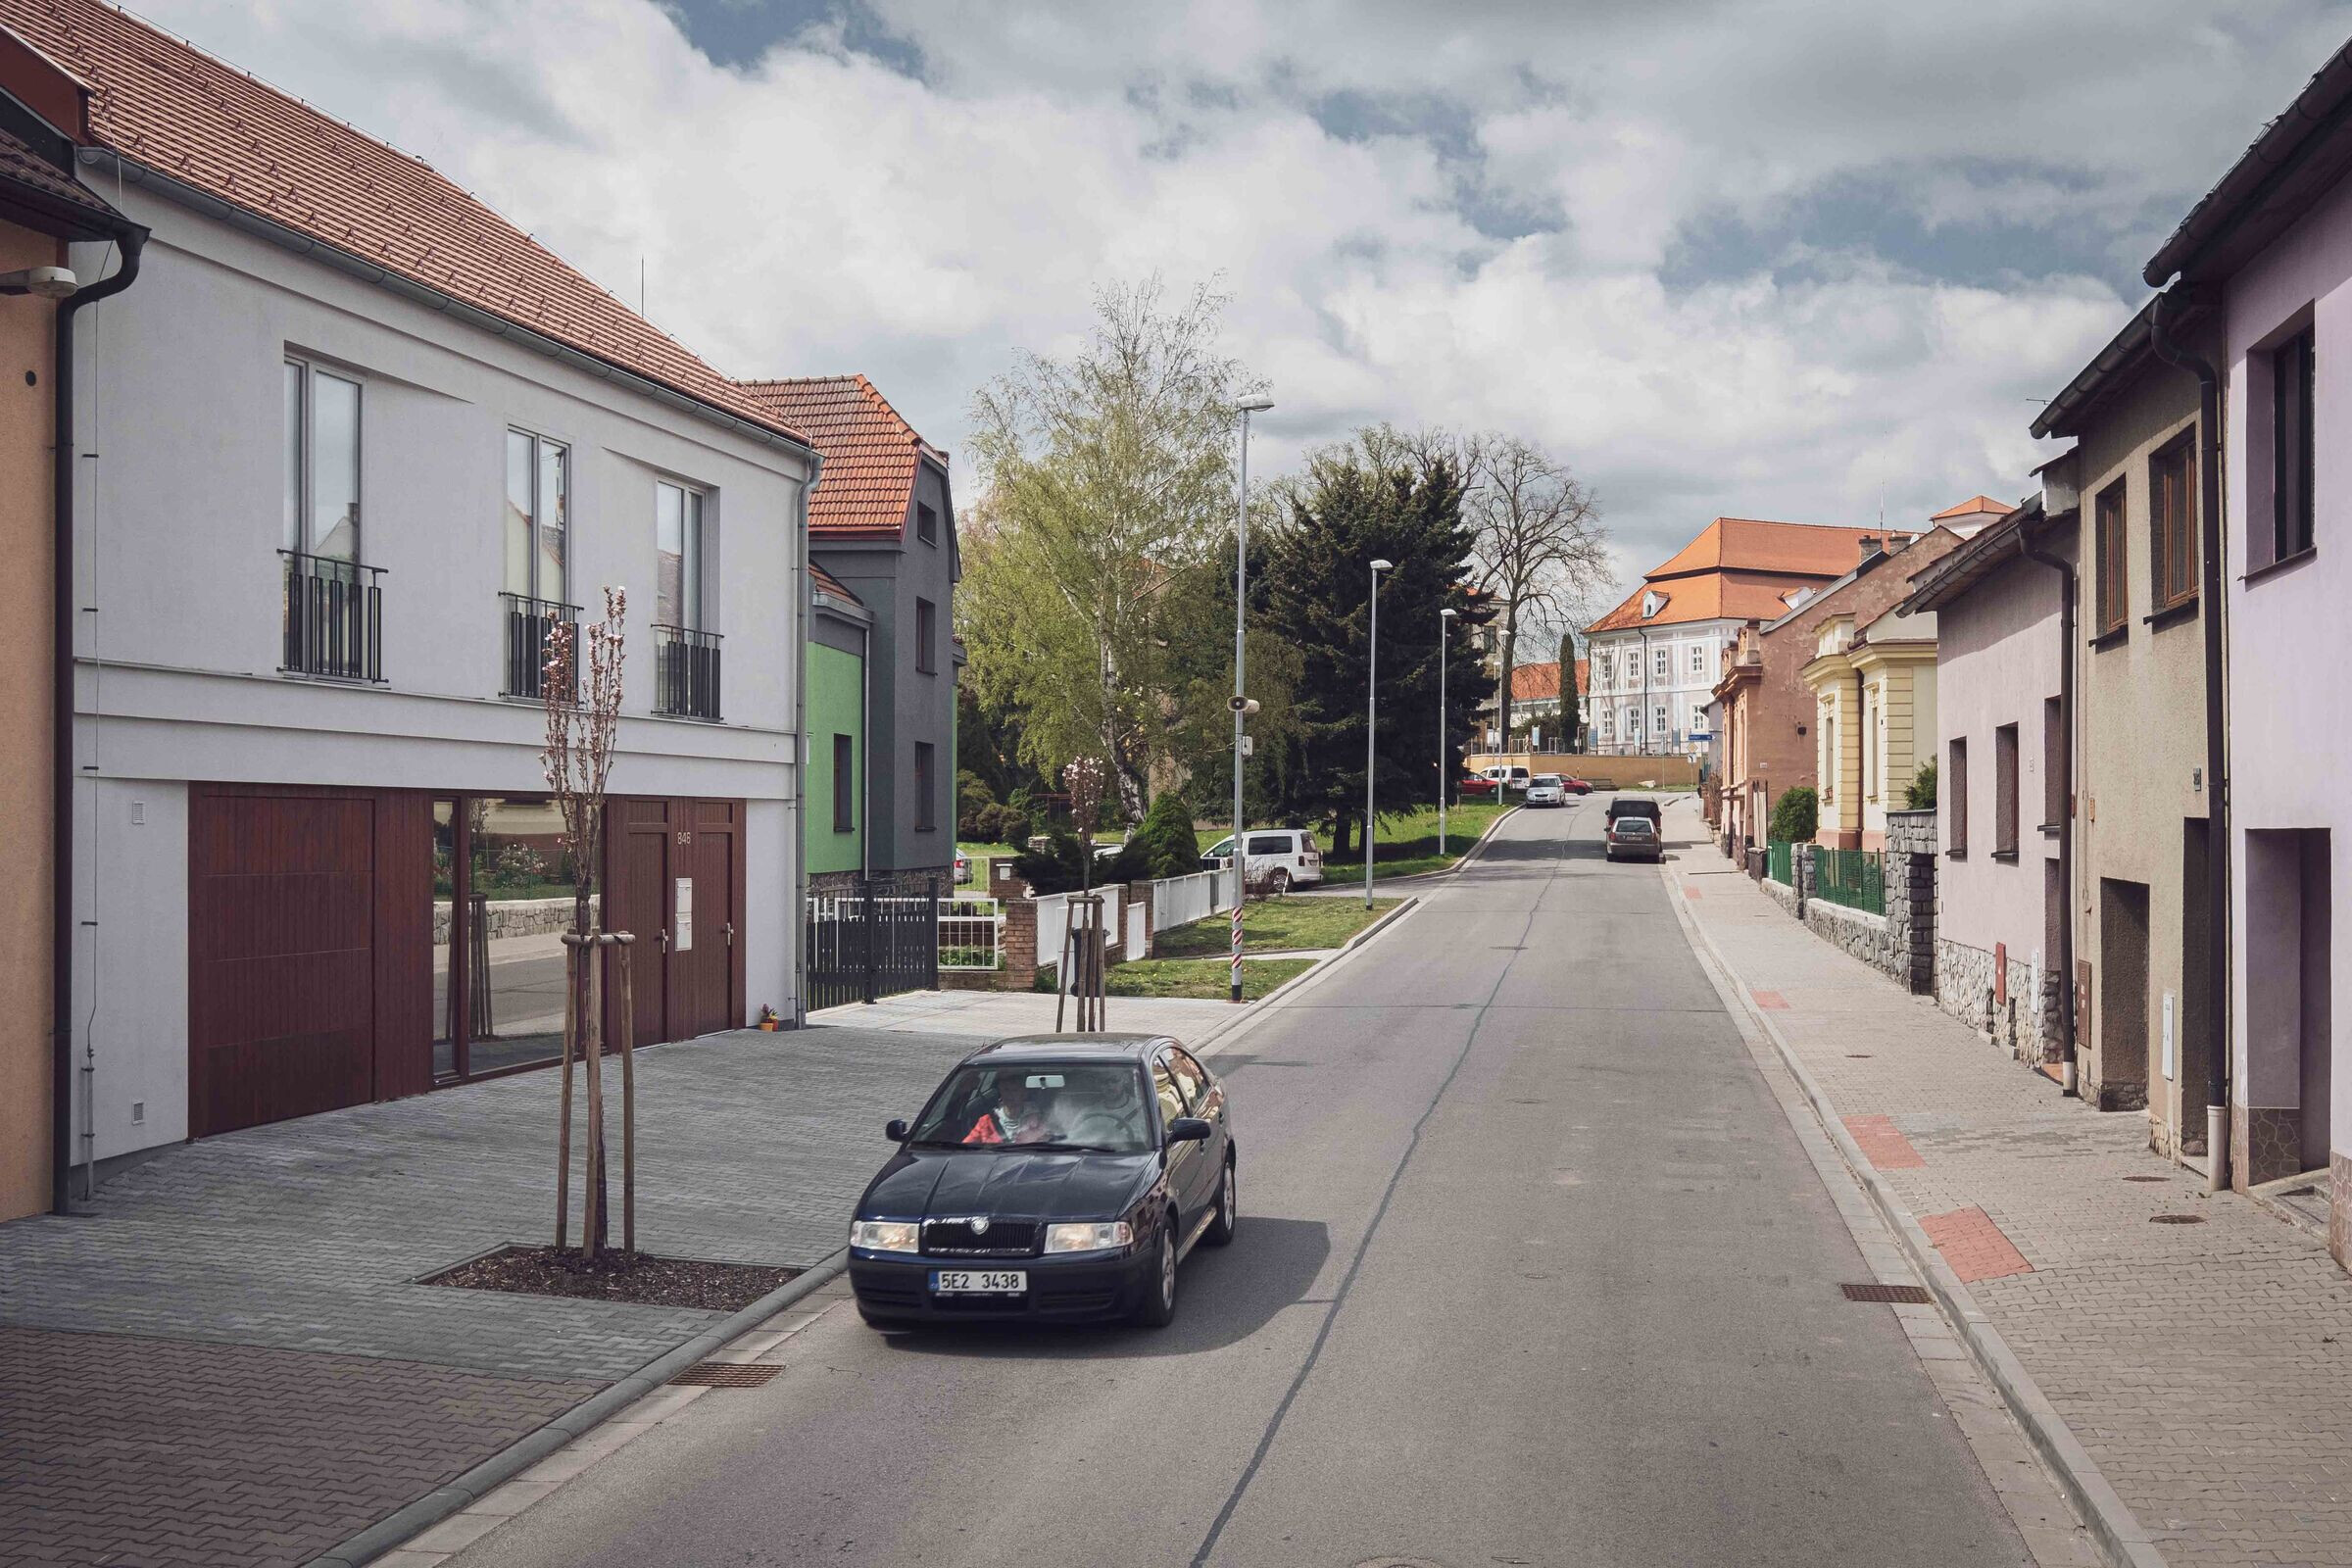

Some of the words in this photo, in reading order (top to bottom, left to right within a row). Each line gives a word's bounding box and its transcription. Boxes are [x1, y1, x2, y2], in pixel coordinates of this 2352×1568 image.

[677, 831, 691, 845] 846
[942, 1274, 970, 1289] 5E2
[981, 1274, 1019, 1289] 3438
